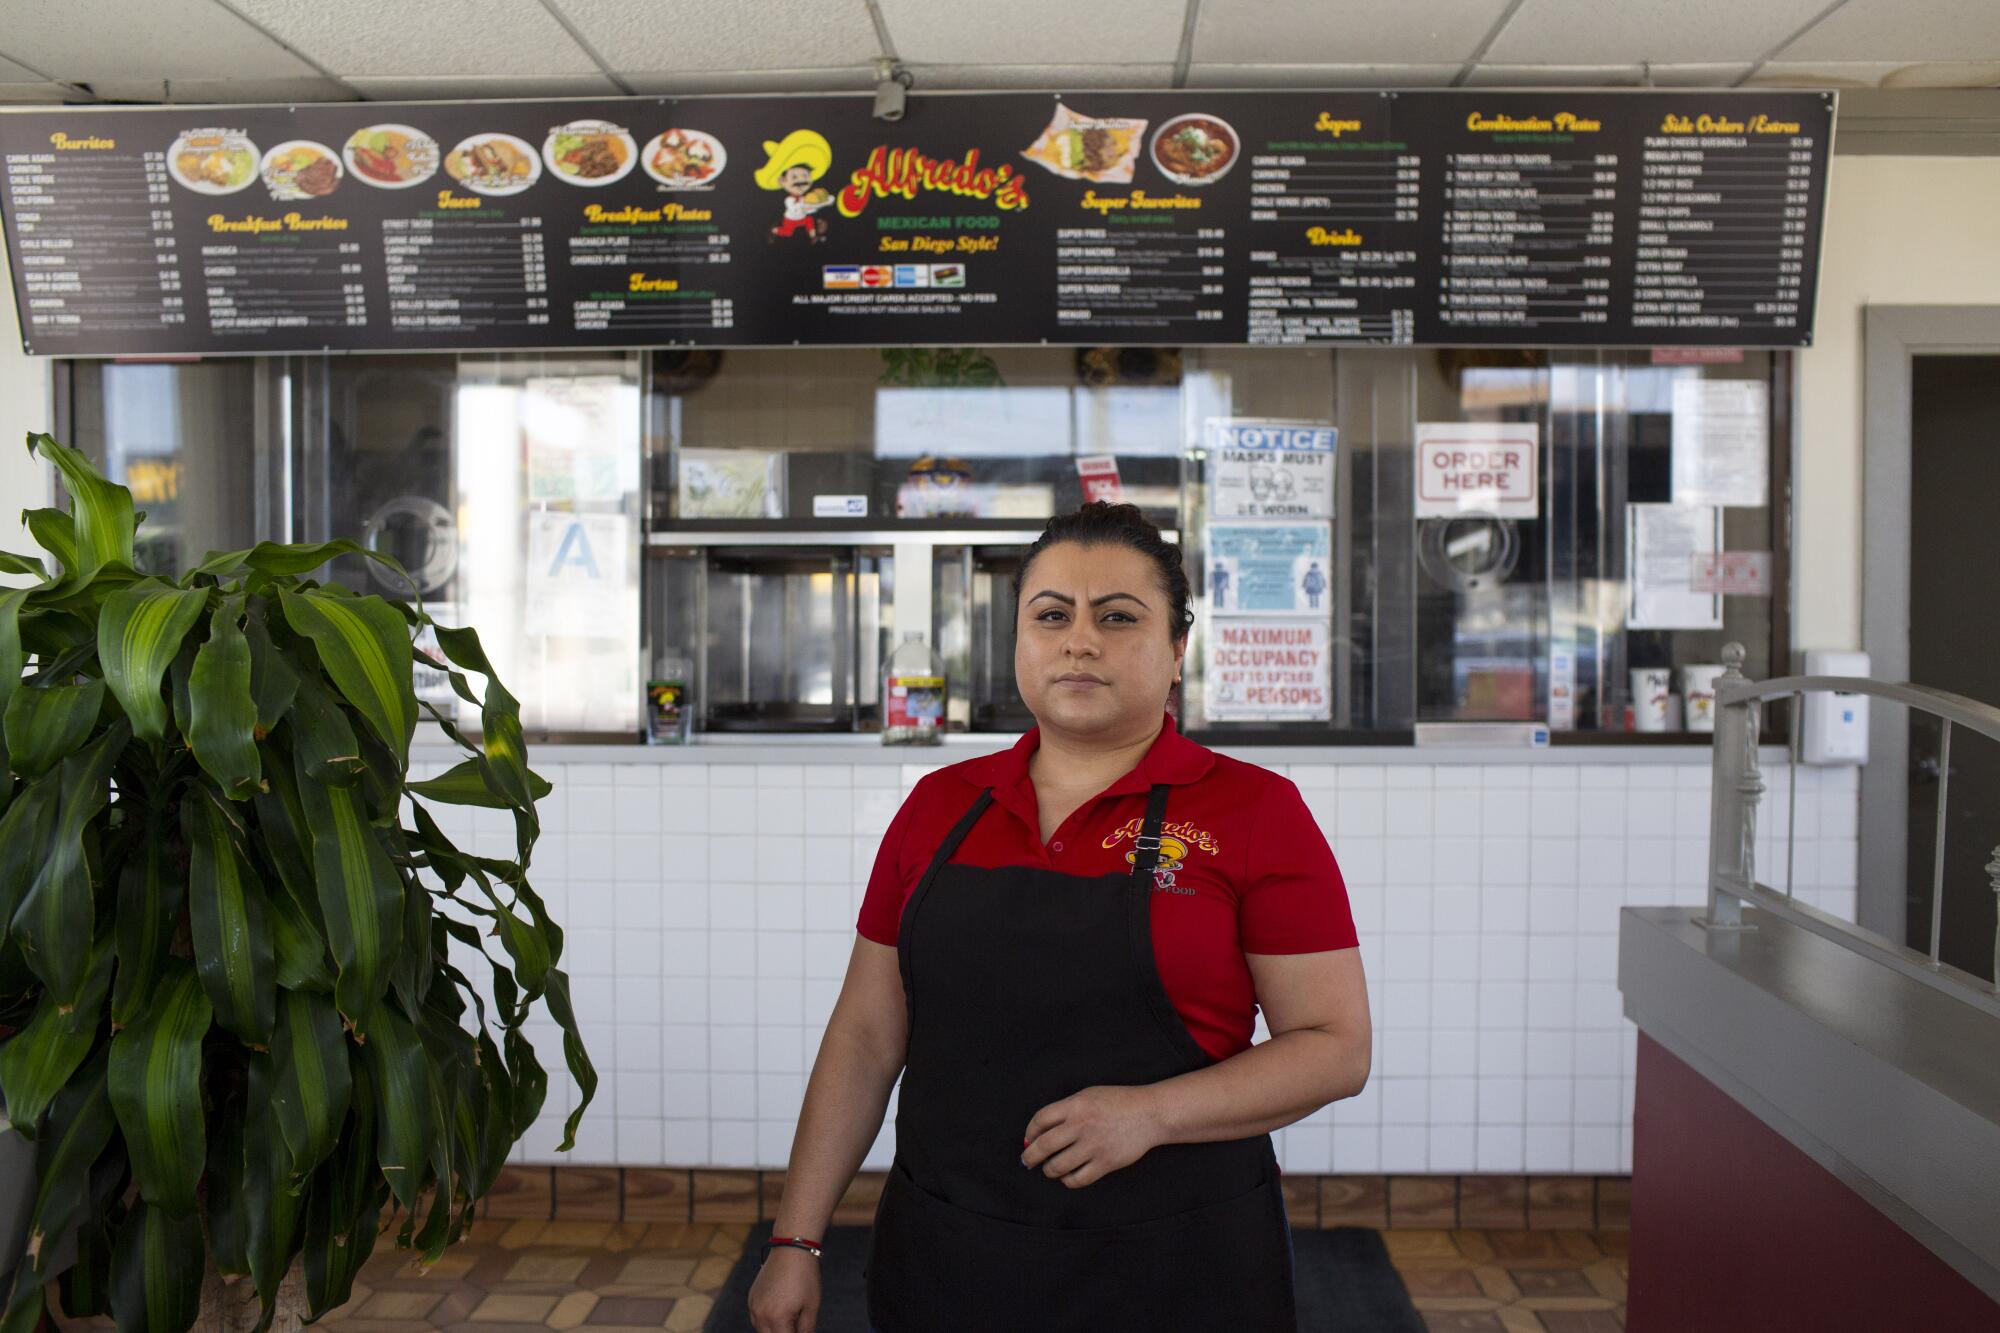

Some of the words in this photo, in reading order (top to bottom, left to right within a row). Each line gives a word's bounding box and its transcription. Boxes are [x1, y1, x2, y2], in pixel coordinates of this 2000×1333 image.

[1314, 111, 1362, 138] Sopes
[1467, 112, 1552, 132] Combination
[1554, 112, 1600, 132] Plates
[1662, 114, 1694, 133] Side
[1696, 114, 1744, 133] Orders
[49, 132, 115, 150] Burritos
[837, 144, 1030, 218] Alfredo's
[438, 190, 480, 208] Tacos
[1081, 190, 1129, 216] Super
[1130, 190, 1202, 208] Favorites
[584, 204, 661, 224] Breakfast
[662, 202, 713, 222] Plates
[208, 214, 282, 234] Breakfast
[284, 212, 348, 232] Burritos
[877, 216, 951, 230] MEXICAN
[956, 216, 1000, 230] FOOD
[879, 236, 909, 252] San
[912, 236, 954, 254] Diego
[956, 236, 1000, 254] Style!
[1306, 226, 1363, 246] Drinks
[628, 272, 679, 292] Tortas
[793, 294, 808, 304] ALL
[812, 294, 842, 304] MAJOR
[844, 294, 874, 304] CREDIT
[876, 294, 905, 303] CARDS
[908, 294, 953, 303] ACCEPTED
[1219, 430, 1332, 450] NOTICE
[1222, 452, 1276, 464] MASKS
[1282, 453, 1324, 464] MUST
[1433, 452, 1520, 469] ORDER
[1444, 472, 1510, 489] HERE
[1264, 504, 1308, 514] WORN
[548, 522, 600, 578] A
[1222, 629, 1312, 645] MAXIMUM
[1215, 650, 1318, 666] OCCUPANCY
[1247, 688, 1322, 704] PERSONS
